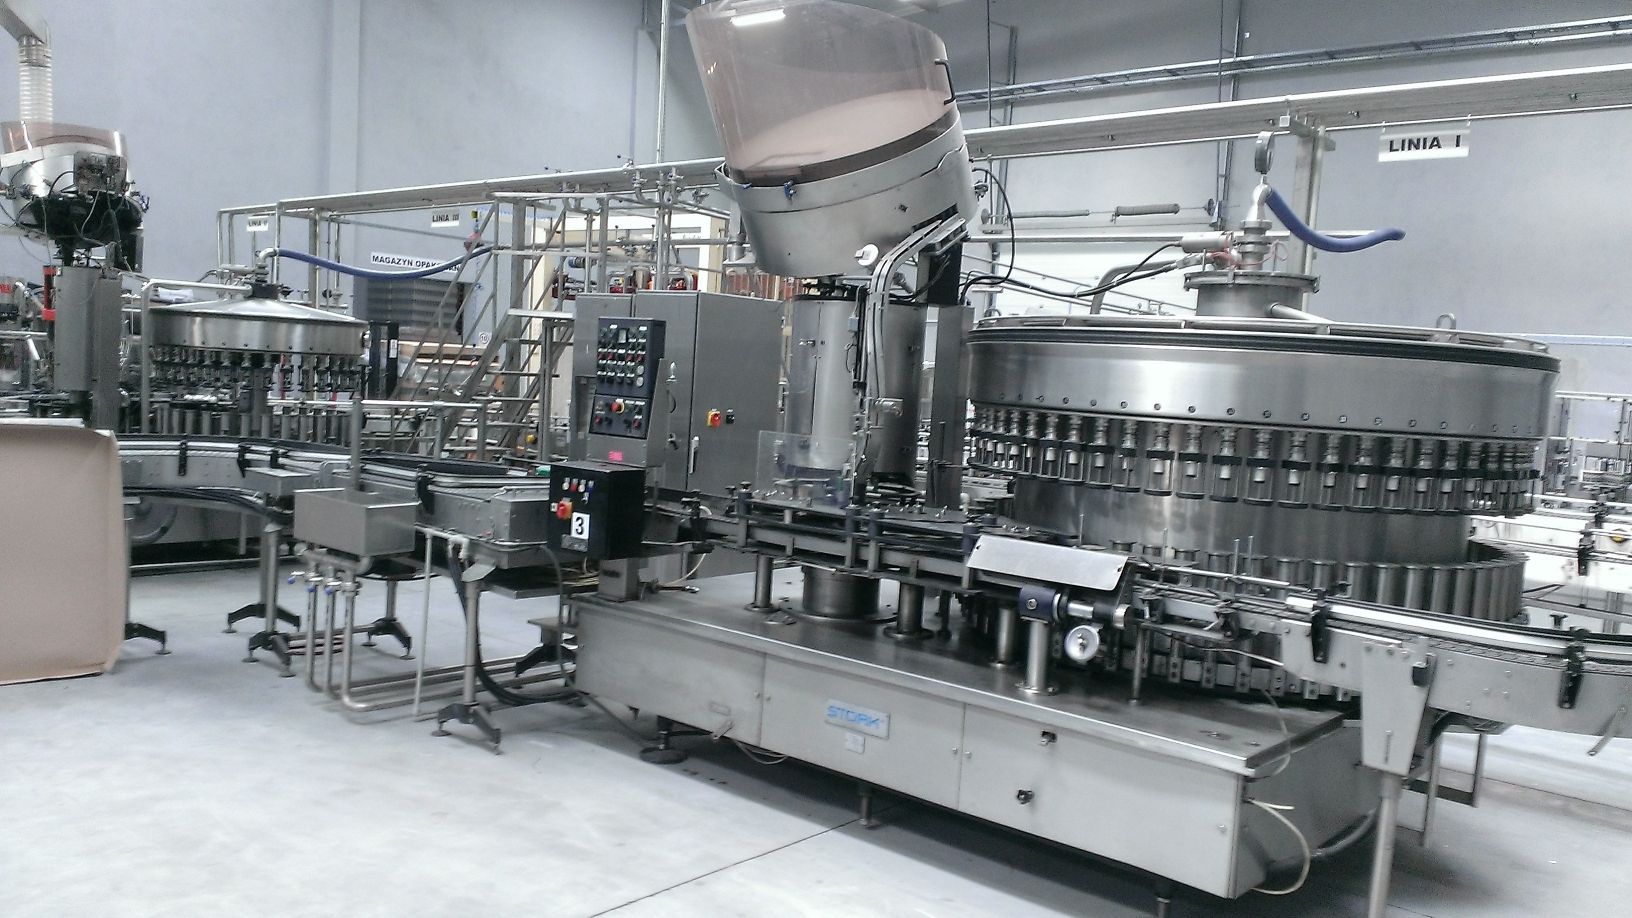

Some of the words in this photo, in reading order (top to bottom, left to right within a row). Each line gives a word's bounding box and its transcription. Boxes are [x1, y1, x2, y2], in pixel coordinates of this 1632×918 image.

[1389, 136, 1442, 152] LINIA
[1455, 135, 1461, 147] I
[432, 214, 450, 222] LINIA
[372, 255, 413, 267] MAGAZYN
[575, 516, 584, 536] 3
[827, 705, 880, 728] STORK
